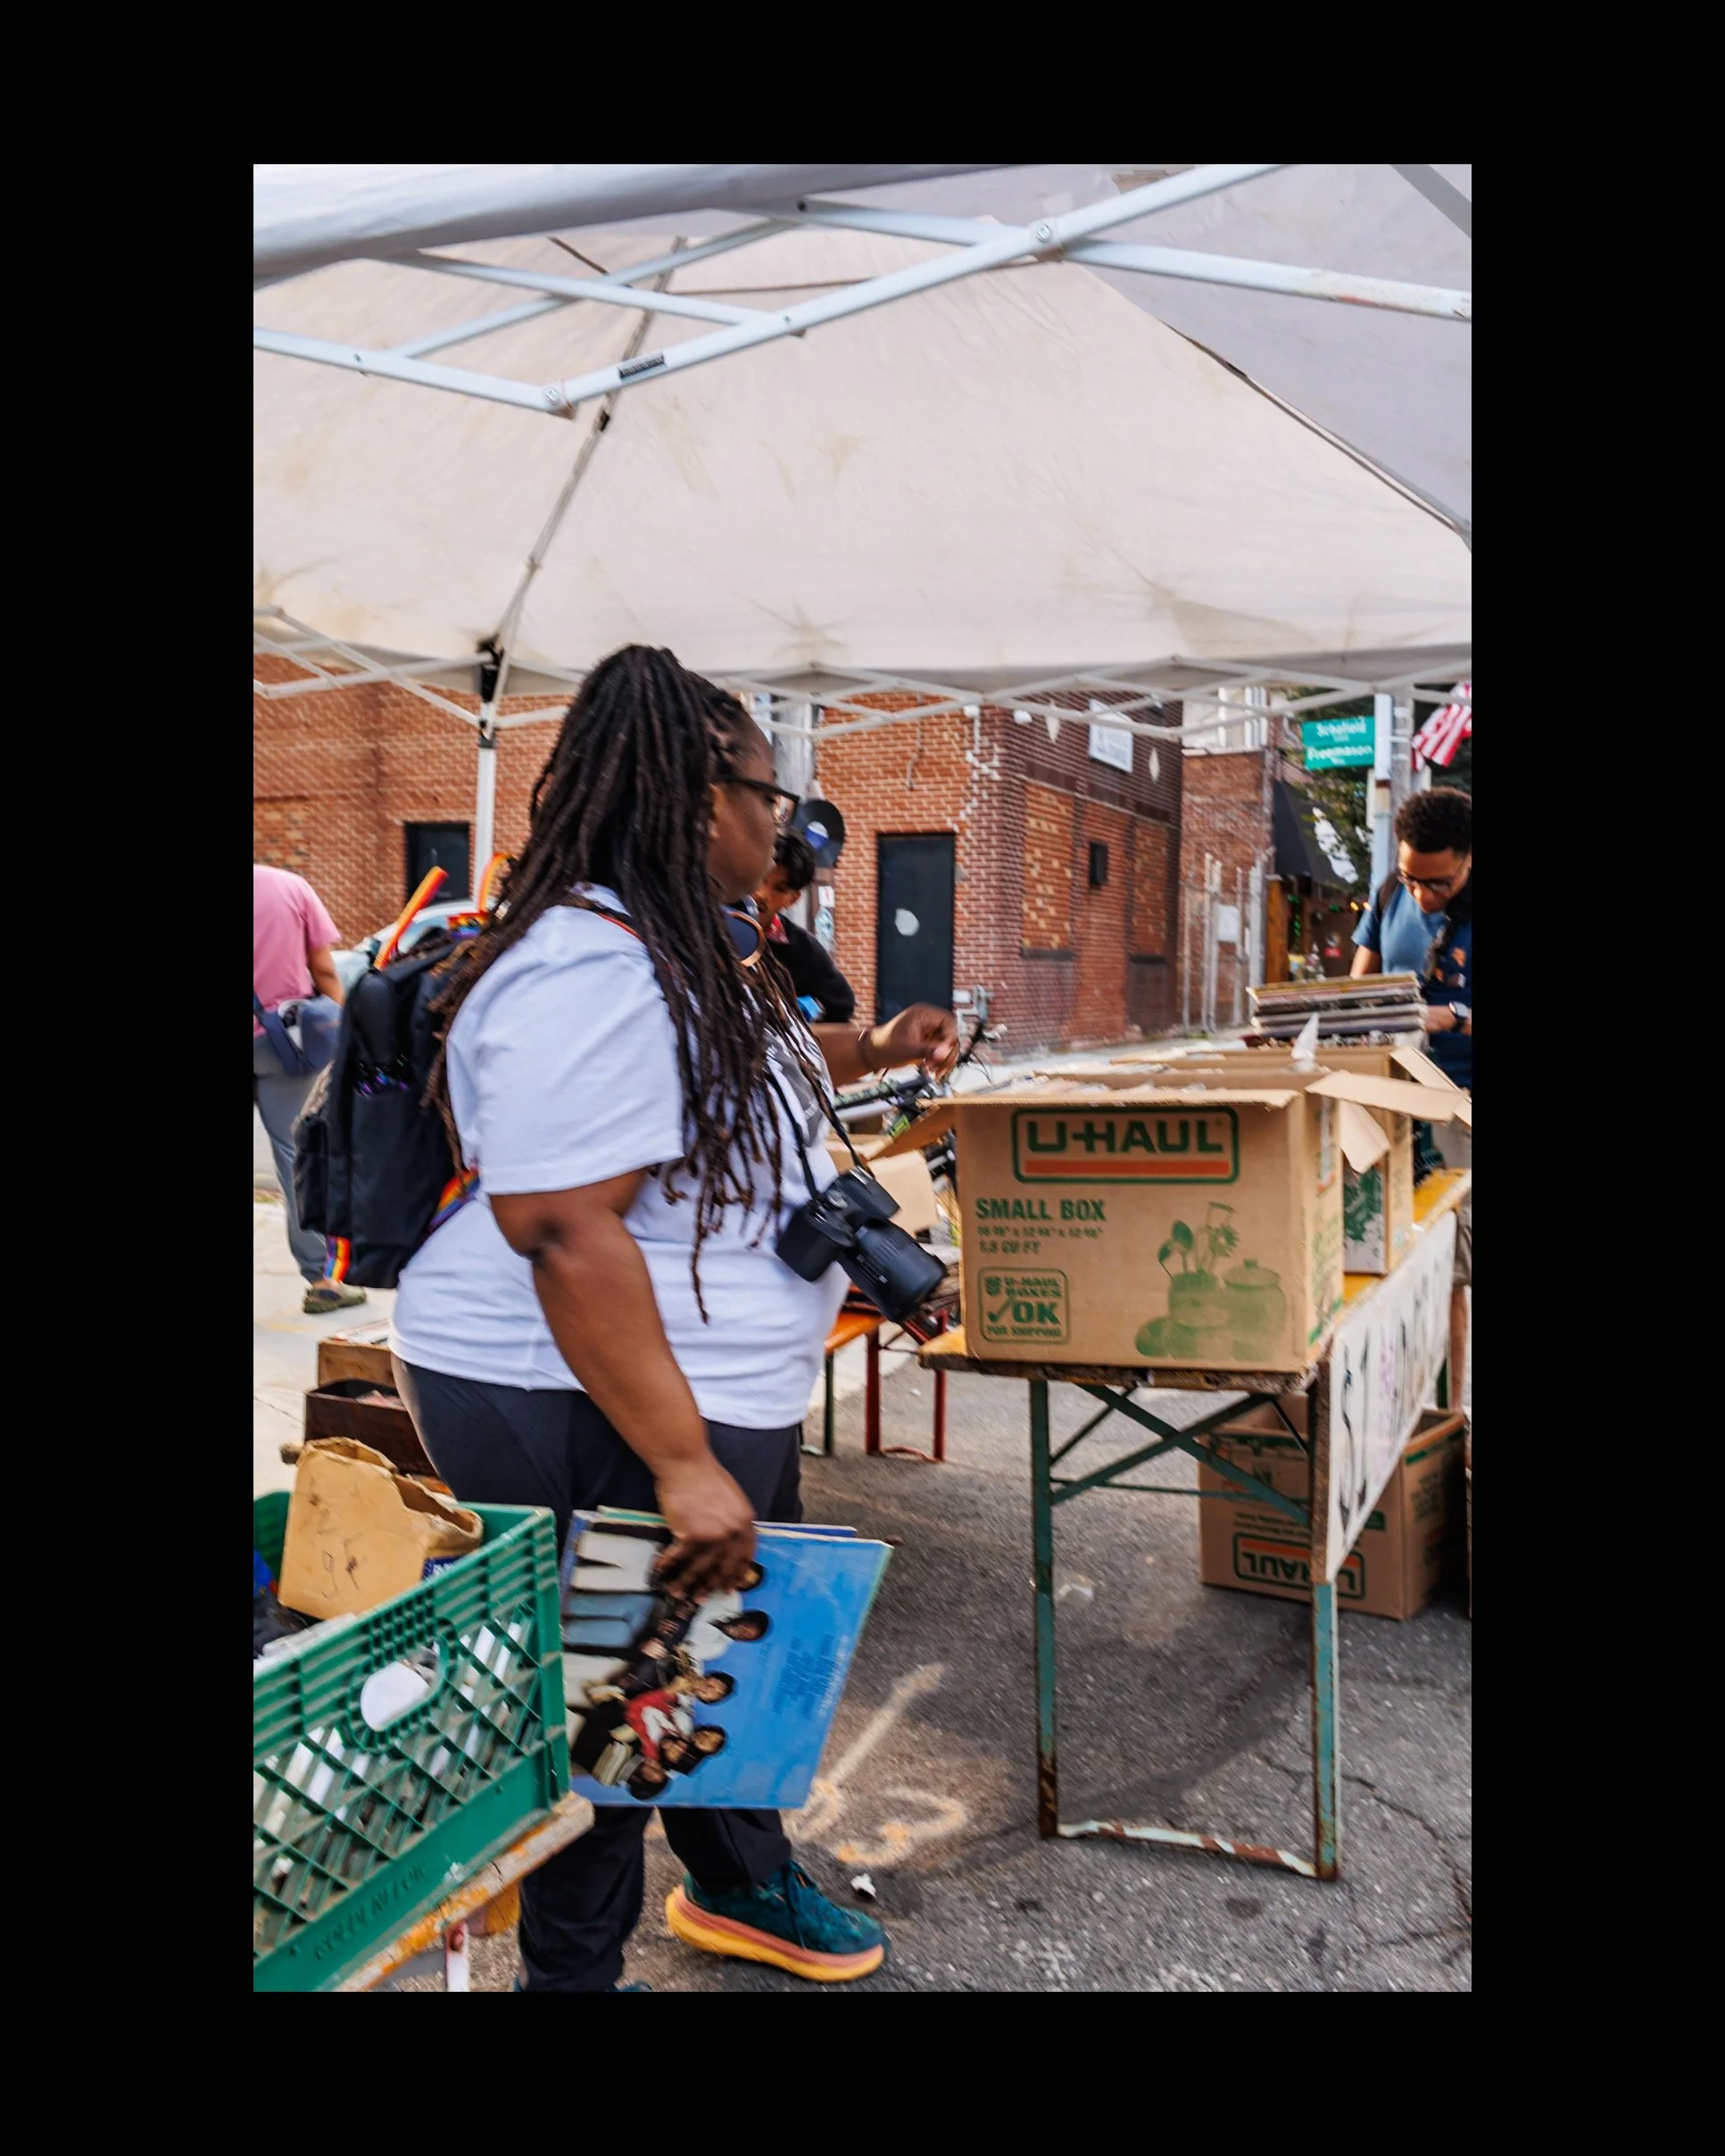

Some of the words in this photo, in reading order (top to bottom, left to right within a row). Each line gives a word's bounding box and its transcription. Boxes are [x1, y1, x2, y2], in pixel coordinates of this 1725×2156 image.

[1027, 1120, 1223, 1153] U-HAUL
[975, 1198, 1052, 1220] SMALL
[1059, 1198, 1107, 1221] BOX
[1006, 1288, 1062, 1298] BOXES
[1013, 1301, 1060, 1323] OK
[1011, 1327, 1062, 1337] SHIPPING
